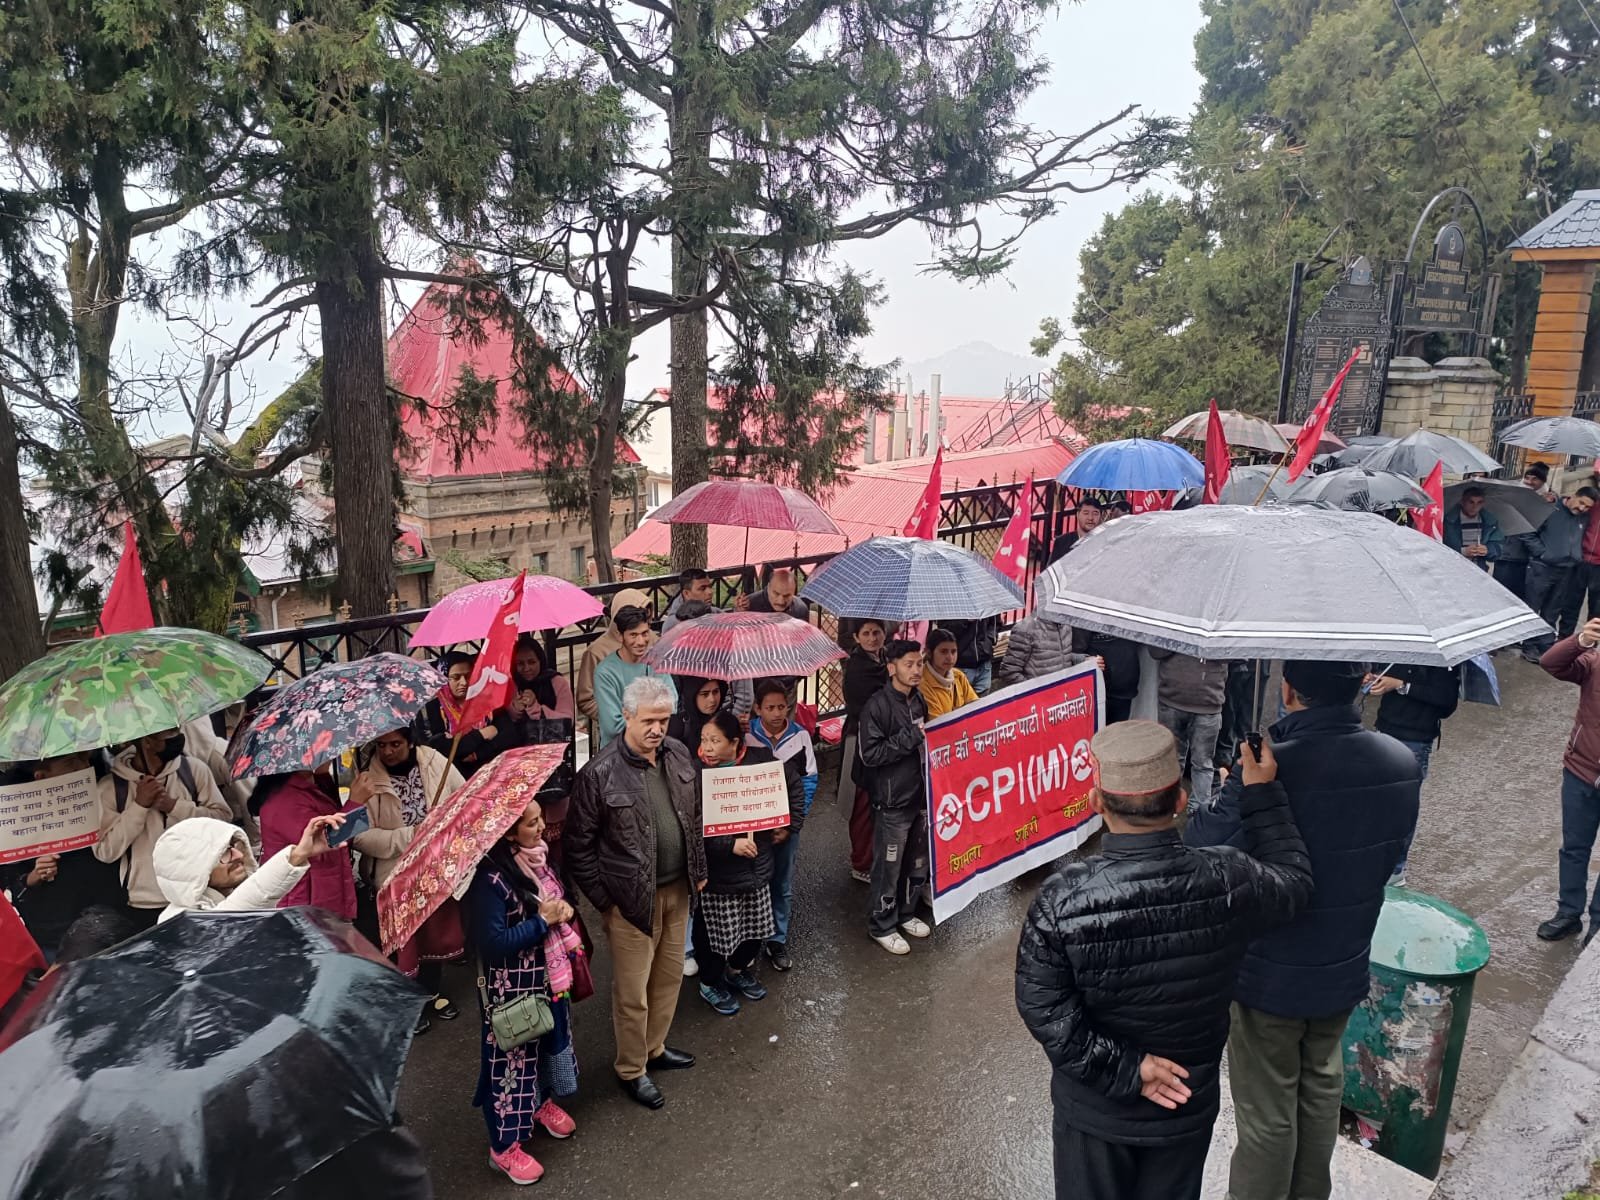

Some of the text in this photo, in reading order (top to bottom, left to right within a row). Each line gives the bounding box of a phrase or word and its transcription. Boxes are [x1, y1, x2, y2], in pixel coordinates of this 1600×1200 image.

[954, 730, 969, 760] की
[712, 776, 736, 784] रोजगार
[738, 774, 751, 783] पैदा
[965, 743, 1069, 822] CPI(M)
[58, 808, 69, 816] का
[720, 804, 739, 814] निवेश
[948, 844, 984, 875] शिमला
[1013, 815, 1040, 843] शहरी
